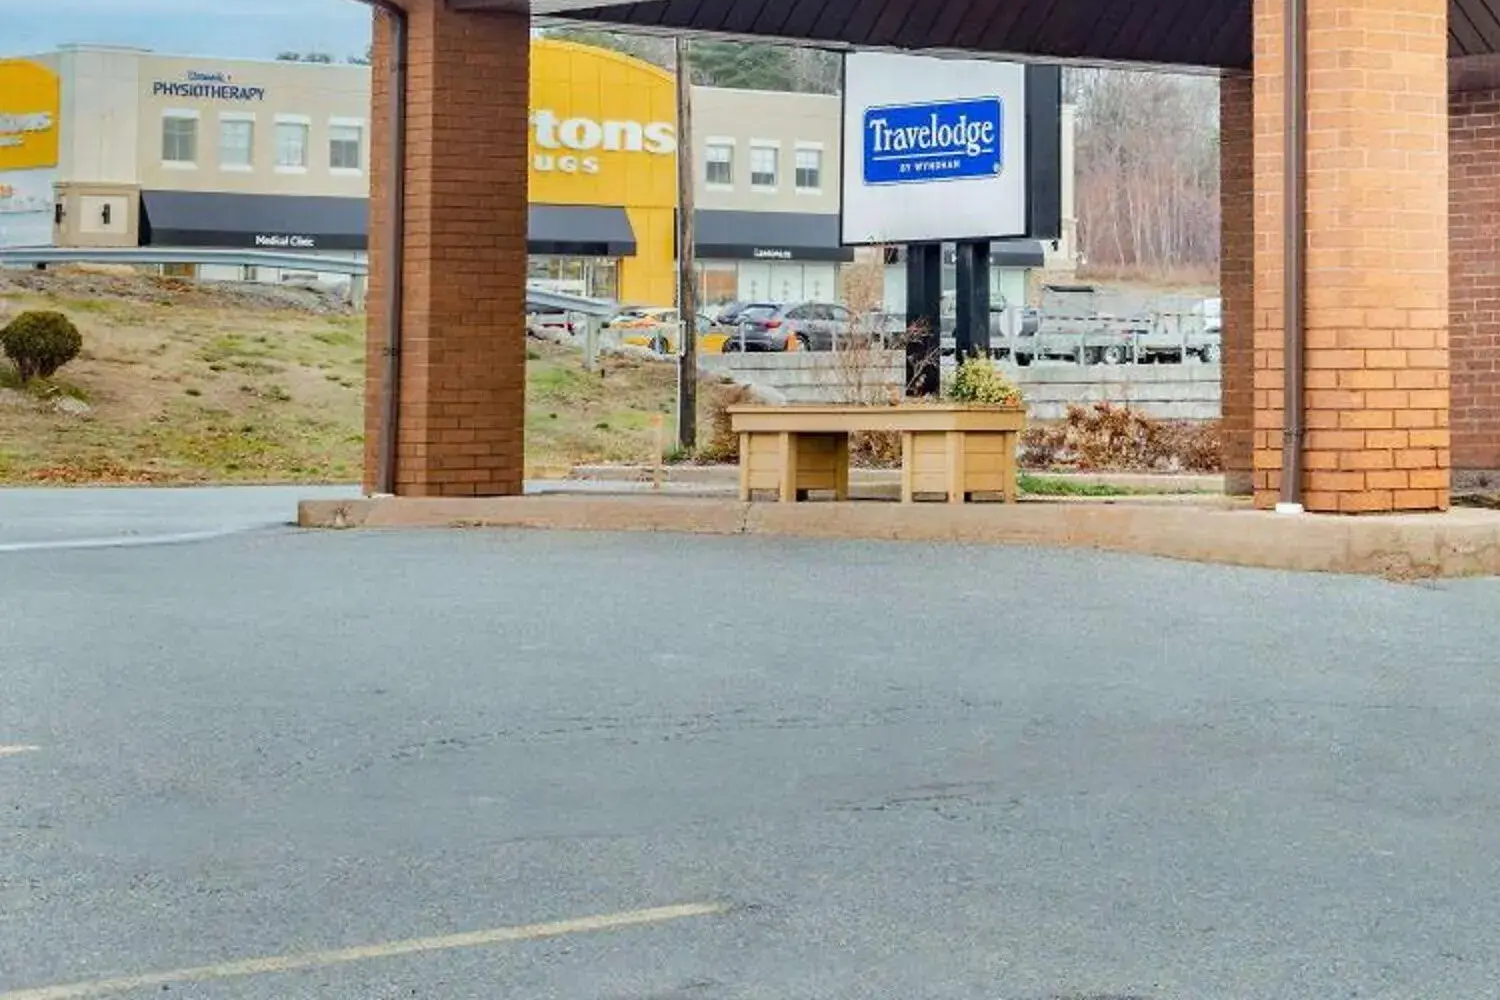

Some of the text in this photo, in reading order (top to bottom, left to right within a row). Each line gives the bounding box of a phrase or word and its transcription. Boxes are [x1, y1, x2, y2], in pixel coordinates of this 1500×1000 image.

[153, 81, 265, 101] PHYSIOTHERAPY
[869, 113, 994, 157] Travelodge
[255, 235, 315, 247] Medical Clinic
